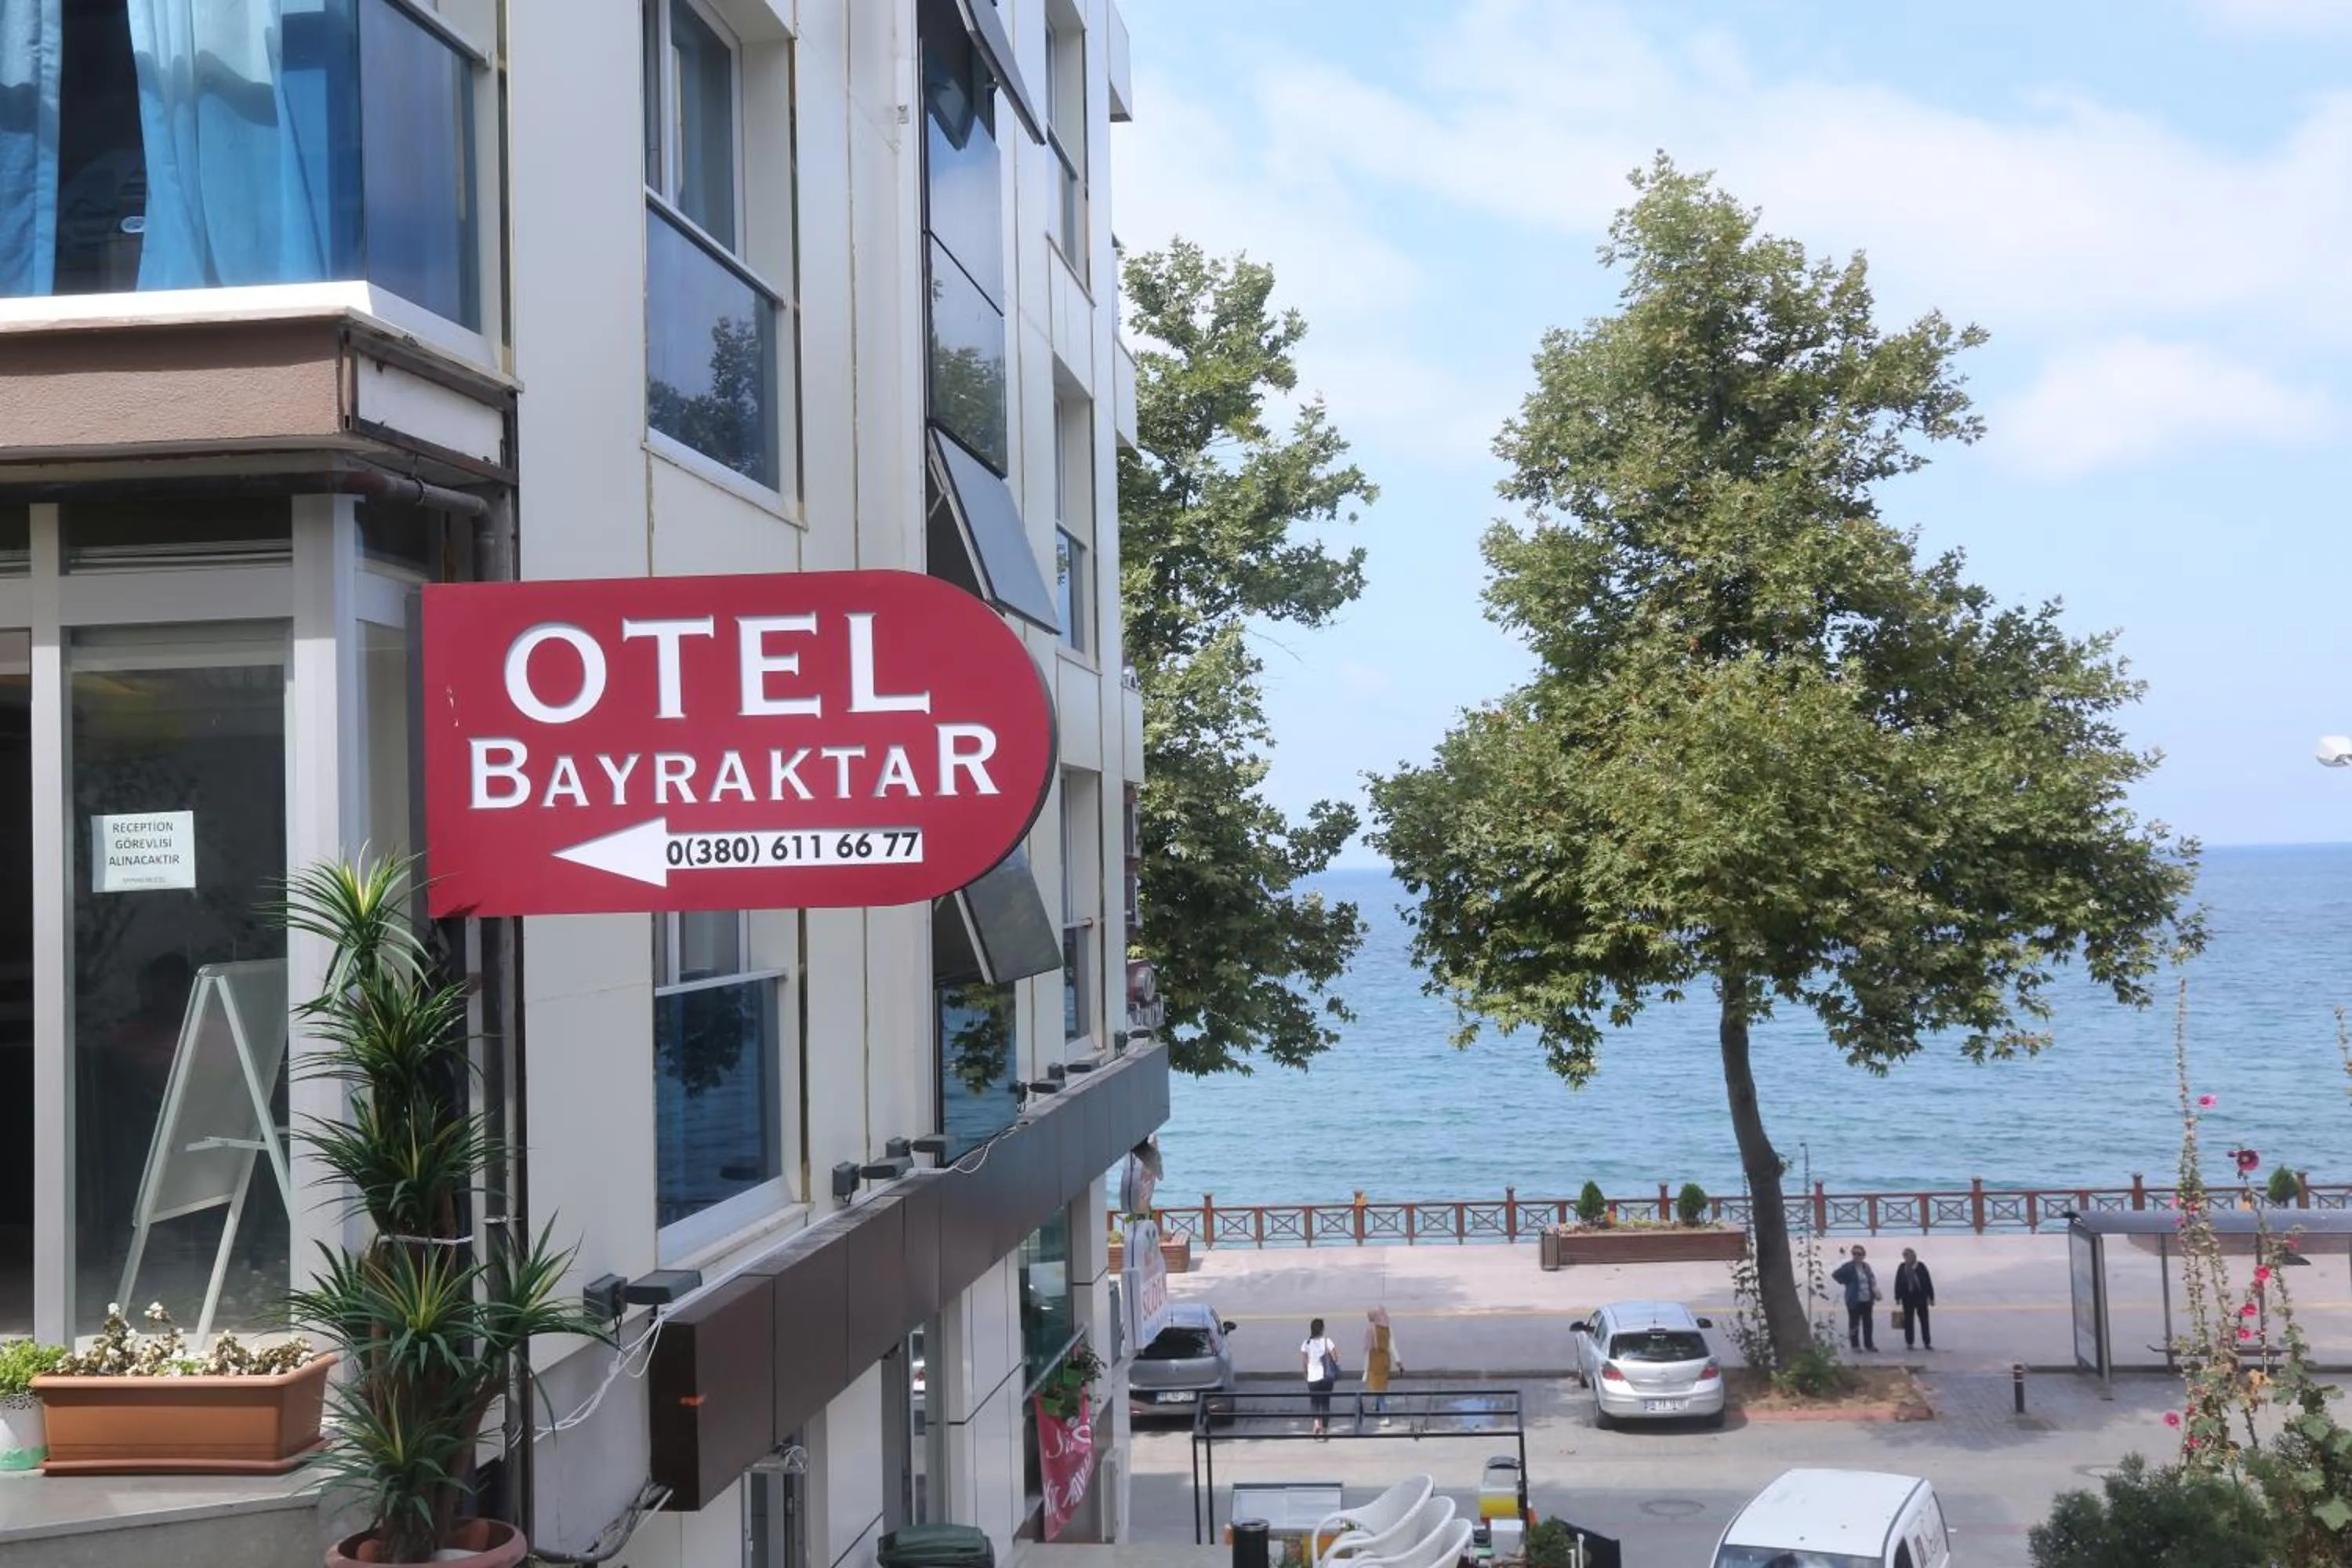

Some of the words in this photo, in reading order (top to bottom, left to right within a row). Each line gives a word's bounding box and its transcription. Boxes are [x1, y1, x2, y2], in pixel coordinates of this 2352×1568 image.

[503, 611, 931, 724] OTEL
[469, 722, 1000, 811] BAYRAKTAR
[108, 854, 180, 866] ALINACAKTIR
[666, 835, 760, 866] 0(380)
[771, 835, 822, 861] 611
[837, 833, 873, 859] 66
[883, 831, 920, 857] 77
